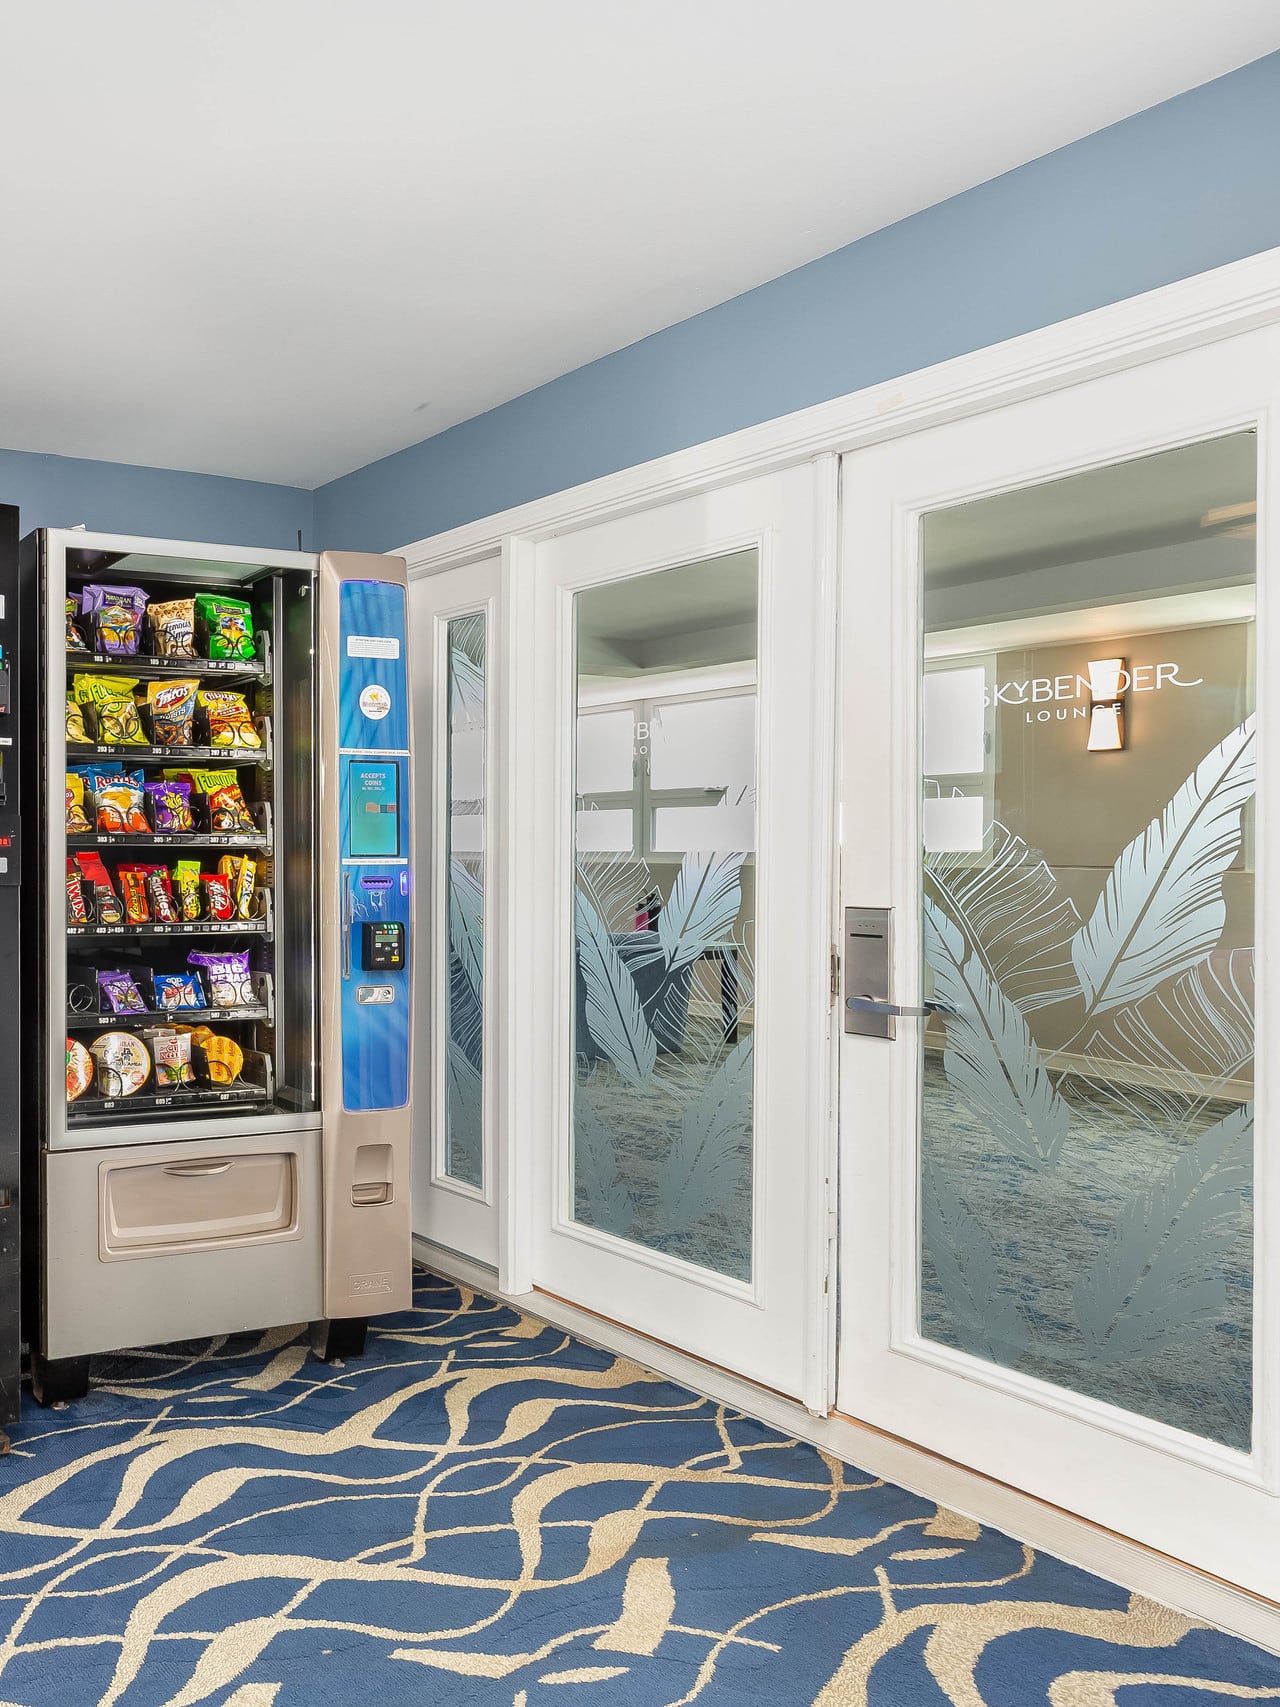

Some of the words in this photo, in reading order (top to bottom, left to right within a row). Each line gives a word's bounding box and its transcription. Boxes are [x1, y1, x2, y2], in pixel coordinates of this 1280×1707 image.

[155, 686, 189, 708] Fritos
[66, 876, 86, 918] TWIX
[211, 963, 244, 974] BIG
[210, 973, 247, 983] TEXAS
